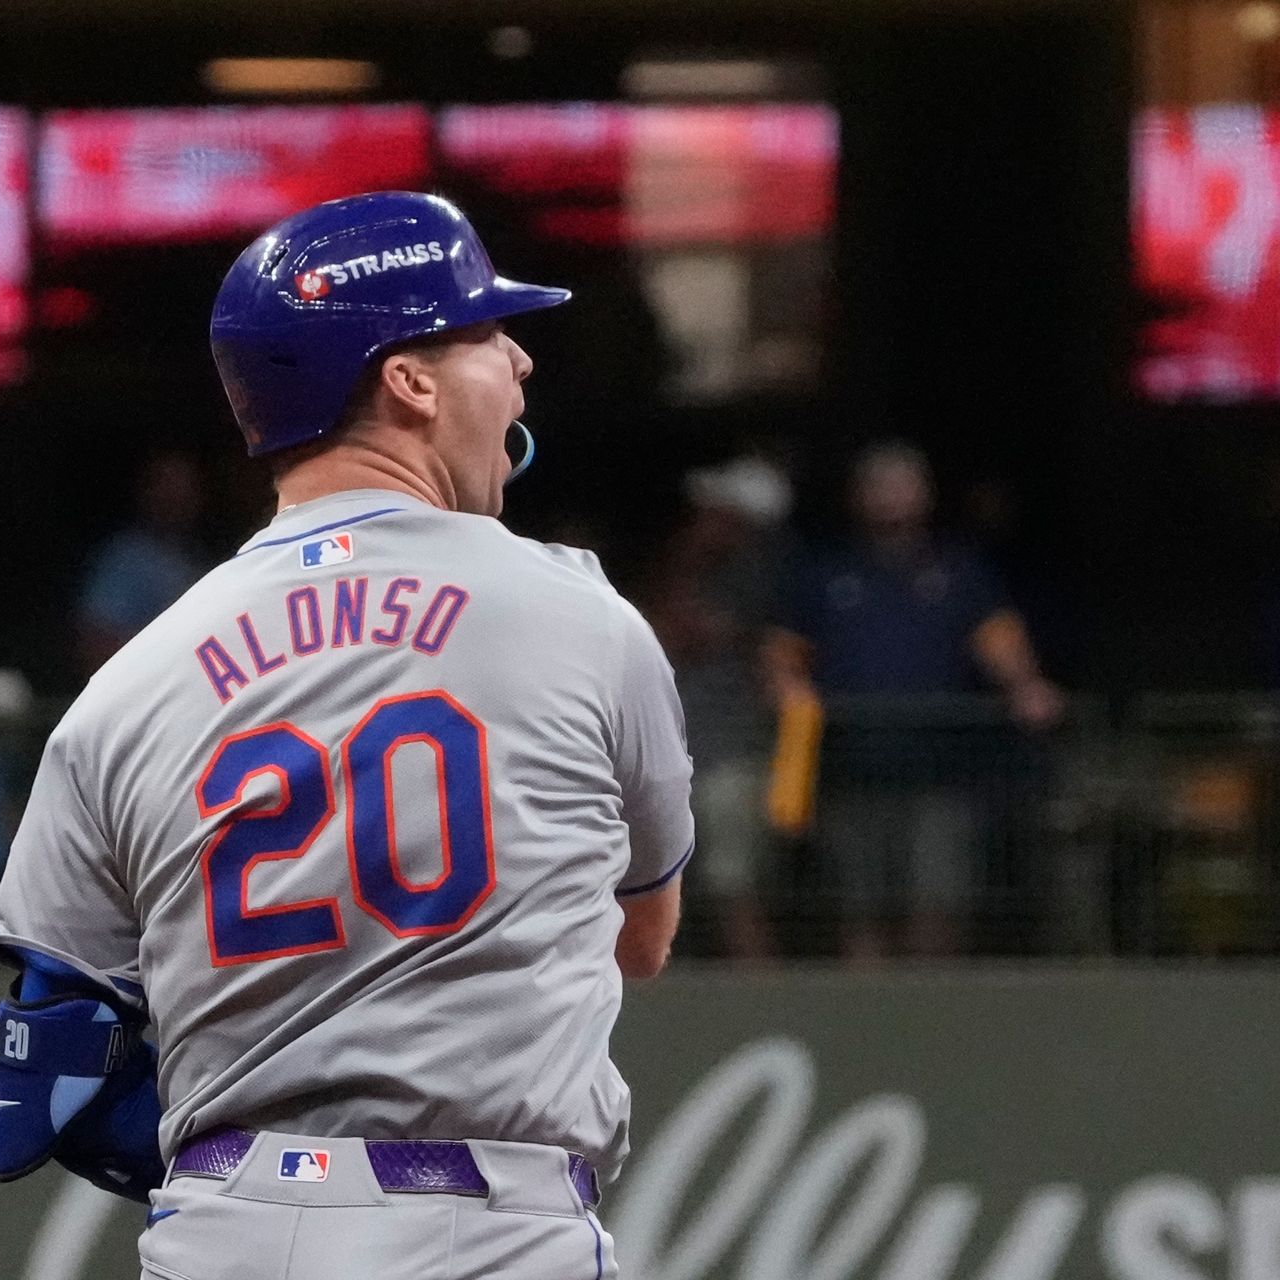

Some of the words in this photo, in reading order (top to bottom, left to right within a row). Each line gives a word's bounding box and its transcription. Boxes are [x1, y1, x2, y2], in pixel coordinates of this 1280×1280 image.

[329, 241, 444, 285] STRAUSS
[195, 576, 470, 705] ALONSO
[195, 688, 496, 968] 20
[4, 1019, 30, 1061] 20
